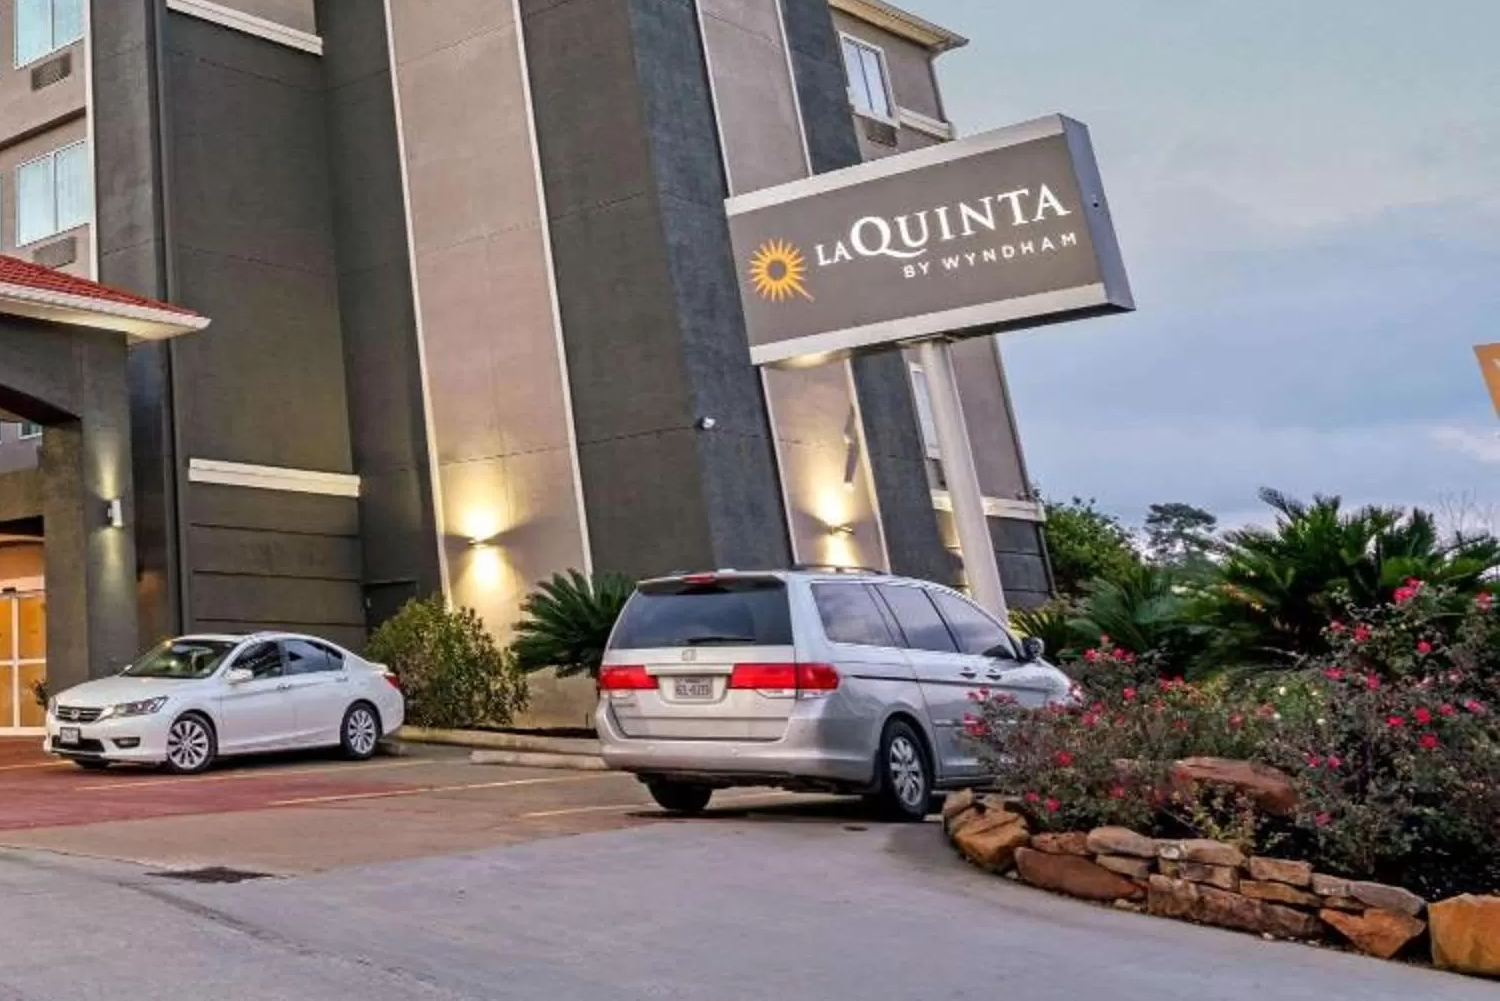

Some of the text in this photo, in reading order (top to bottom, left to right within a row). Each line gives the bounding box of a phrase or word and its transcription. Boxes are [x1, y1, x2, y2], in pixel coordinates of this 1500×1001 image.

[814, 183, 1071, 267] LA QUINTA
[903, 232, 1078, 279] BY WYNDHAM
